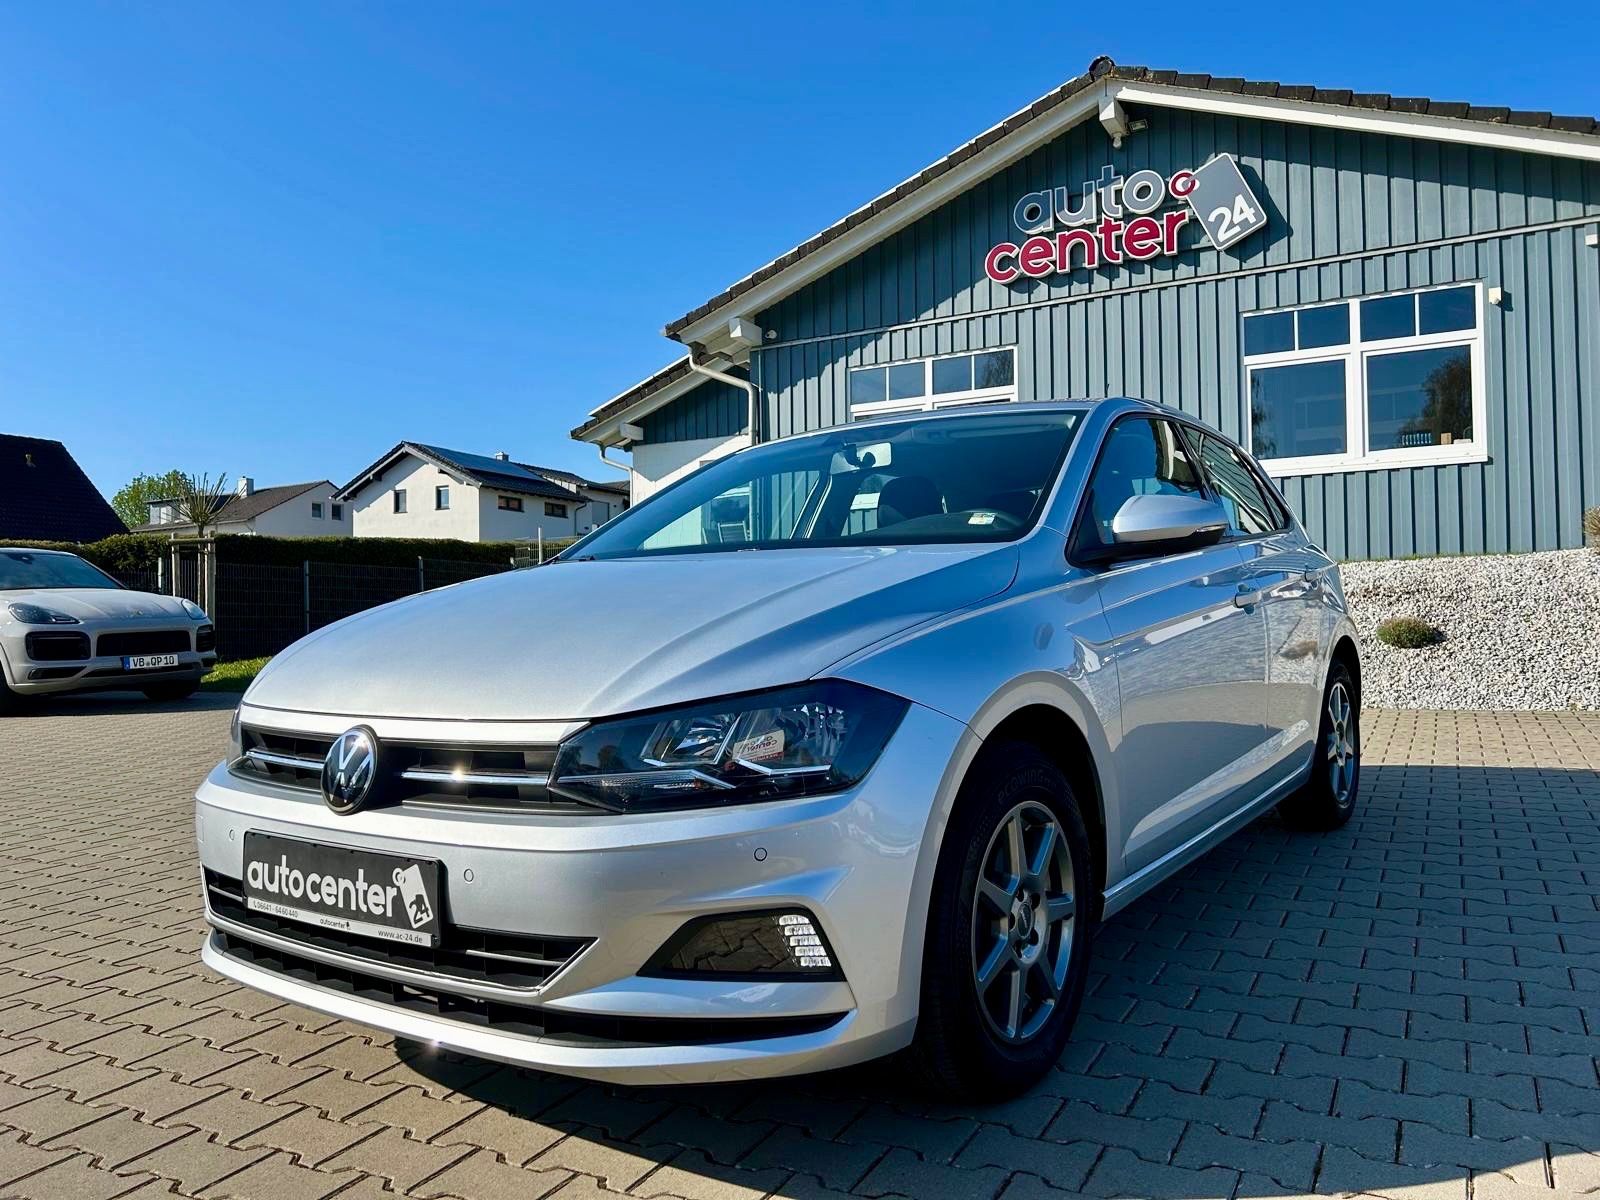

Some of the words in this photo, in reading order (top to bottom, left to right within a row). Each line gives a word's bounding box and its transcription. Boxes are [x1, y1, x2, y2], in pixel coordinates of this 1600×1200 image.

[1013, 165, 1166, 235] auto
[1208, 194, 1255, 242] 24
[985, 209, 1191, 284] center
[132, 657, 145, 667] VB
[150, 656, 162, 666] QP
[163, 655, 175, 665] 10
[247, 854, 397, 918] autocenter
[409, 899, 432, 924] 24
[319, 918, 346, 930] autocenter
[377, 928, 423, 944] www.ac-24.de
